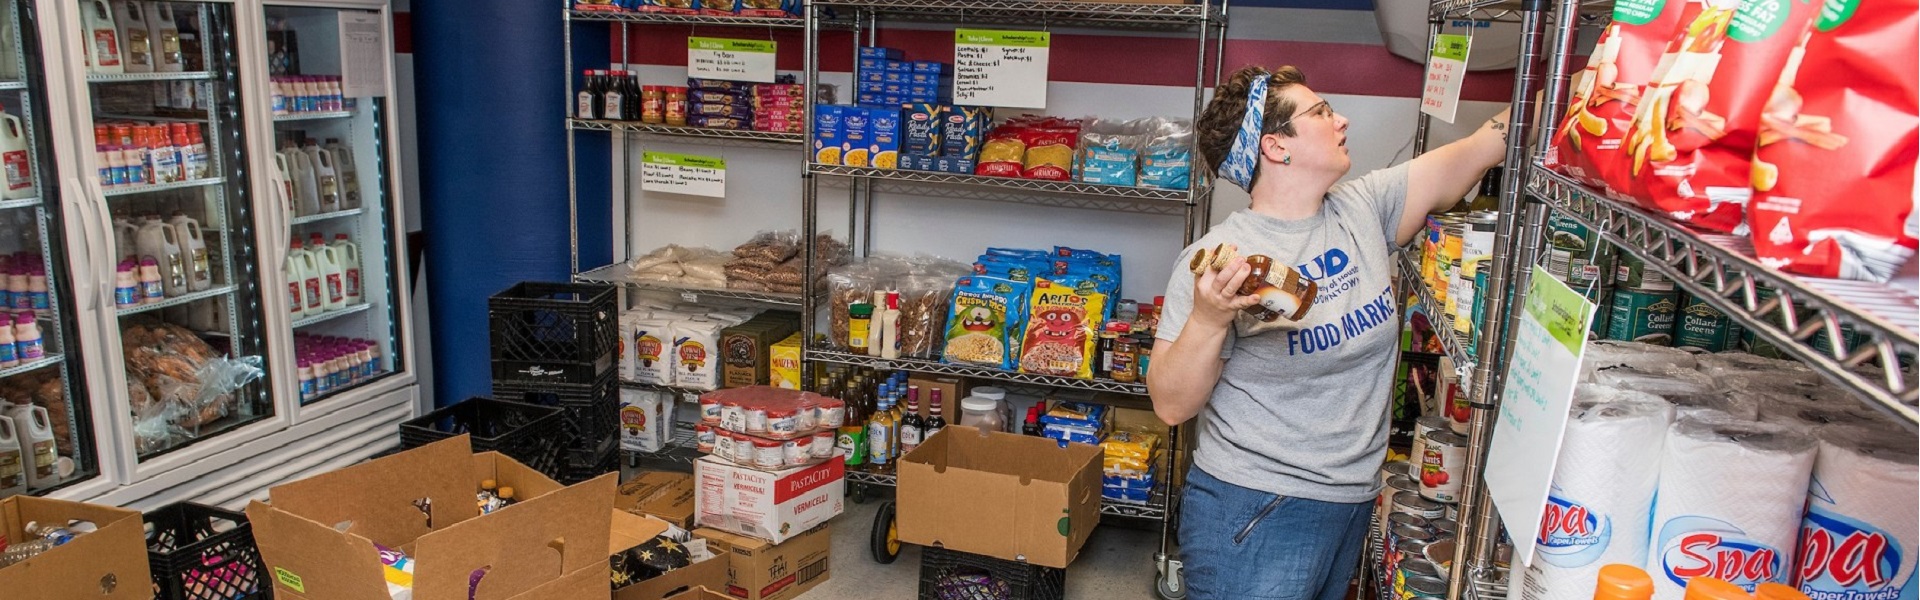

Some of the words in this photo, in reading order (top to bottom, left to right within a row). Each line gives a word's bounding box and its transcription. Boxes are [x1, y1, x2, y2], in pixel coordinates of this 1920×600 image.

[908, 120, 930, 132] Ready
[945, 122, 966, 135] Ready
[909, 129, 927, 138] Pasta
[946, 132, 962, 140] Pasta
[956, 296, 988, 307] CRISPY
[989, 300, 1006, 312] RICE
[1287, 322, 1341, 356] FOOD
[1341, 285, 1395, 340] MARKET
[1648, 313, 1675, 322] Collard
[1684, 316, 1717, 328] Collard
[1648, 322, 1672, 330] Greens
[1684, 324, 1715, 335] Greens
[772, 358, 798, 370] MAIZENA
[734, 483, 765, 495] VERMICELLI
[794, 494, 828, 516] VERMICELLI
[1541, 503, 1590, 545] pa
[1673, 532, 1775, 581] Spa
[1794, 527, 1890, 590] pa
[1804, 585, 1841, 600] Paper
[1842, 587, 1901, 600] Towels
